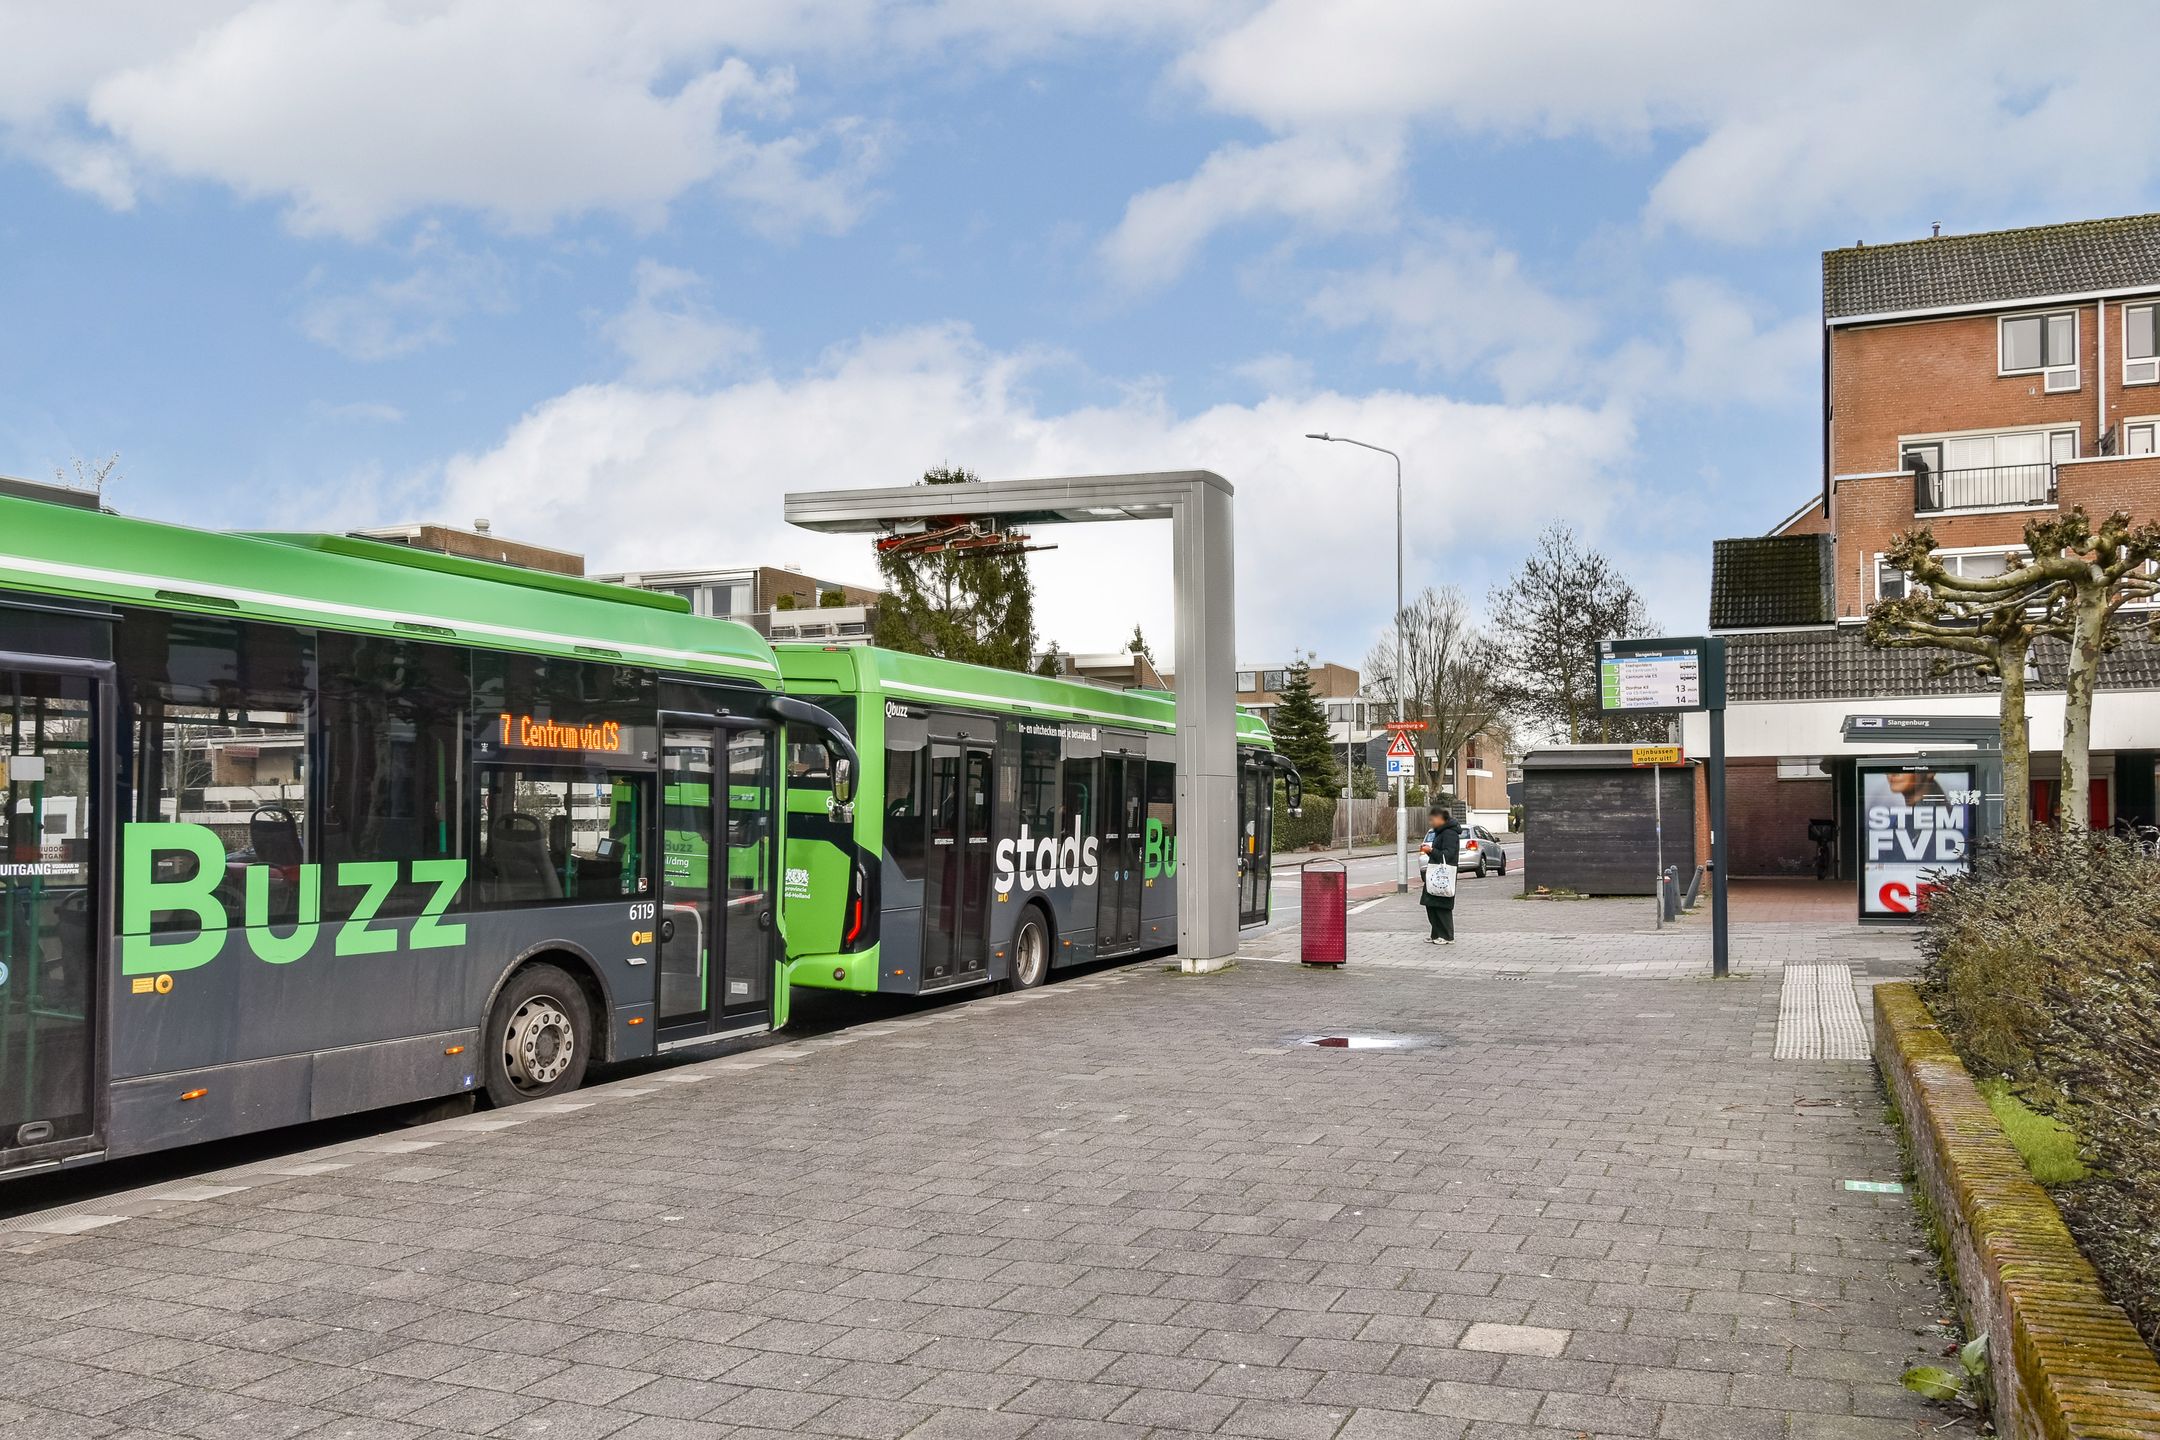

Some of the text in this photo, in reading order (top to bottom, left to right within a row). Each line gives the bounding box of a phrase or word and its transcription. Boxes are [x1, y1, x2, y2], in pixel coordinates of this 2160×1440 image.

[1613, 665, 1619, 673] 5
[1676, 685, 1686, 693] 13
[886, 701, 908, 718] Qbuzz
[501, 714, 619, 751] 7 Centrum via CS
[1390, 761, 1398, 771] P
[1868, 805, 1964, 830] STEM
[1868, 829, 1966, 861] FVD
[994, 814, 1177, 894] stads Bu
[0, 863, 52, 876] UITGANG
[629, 903, 655, 921] 6119
